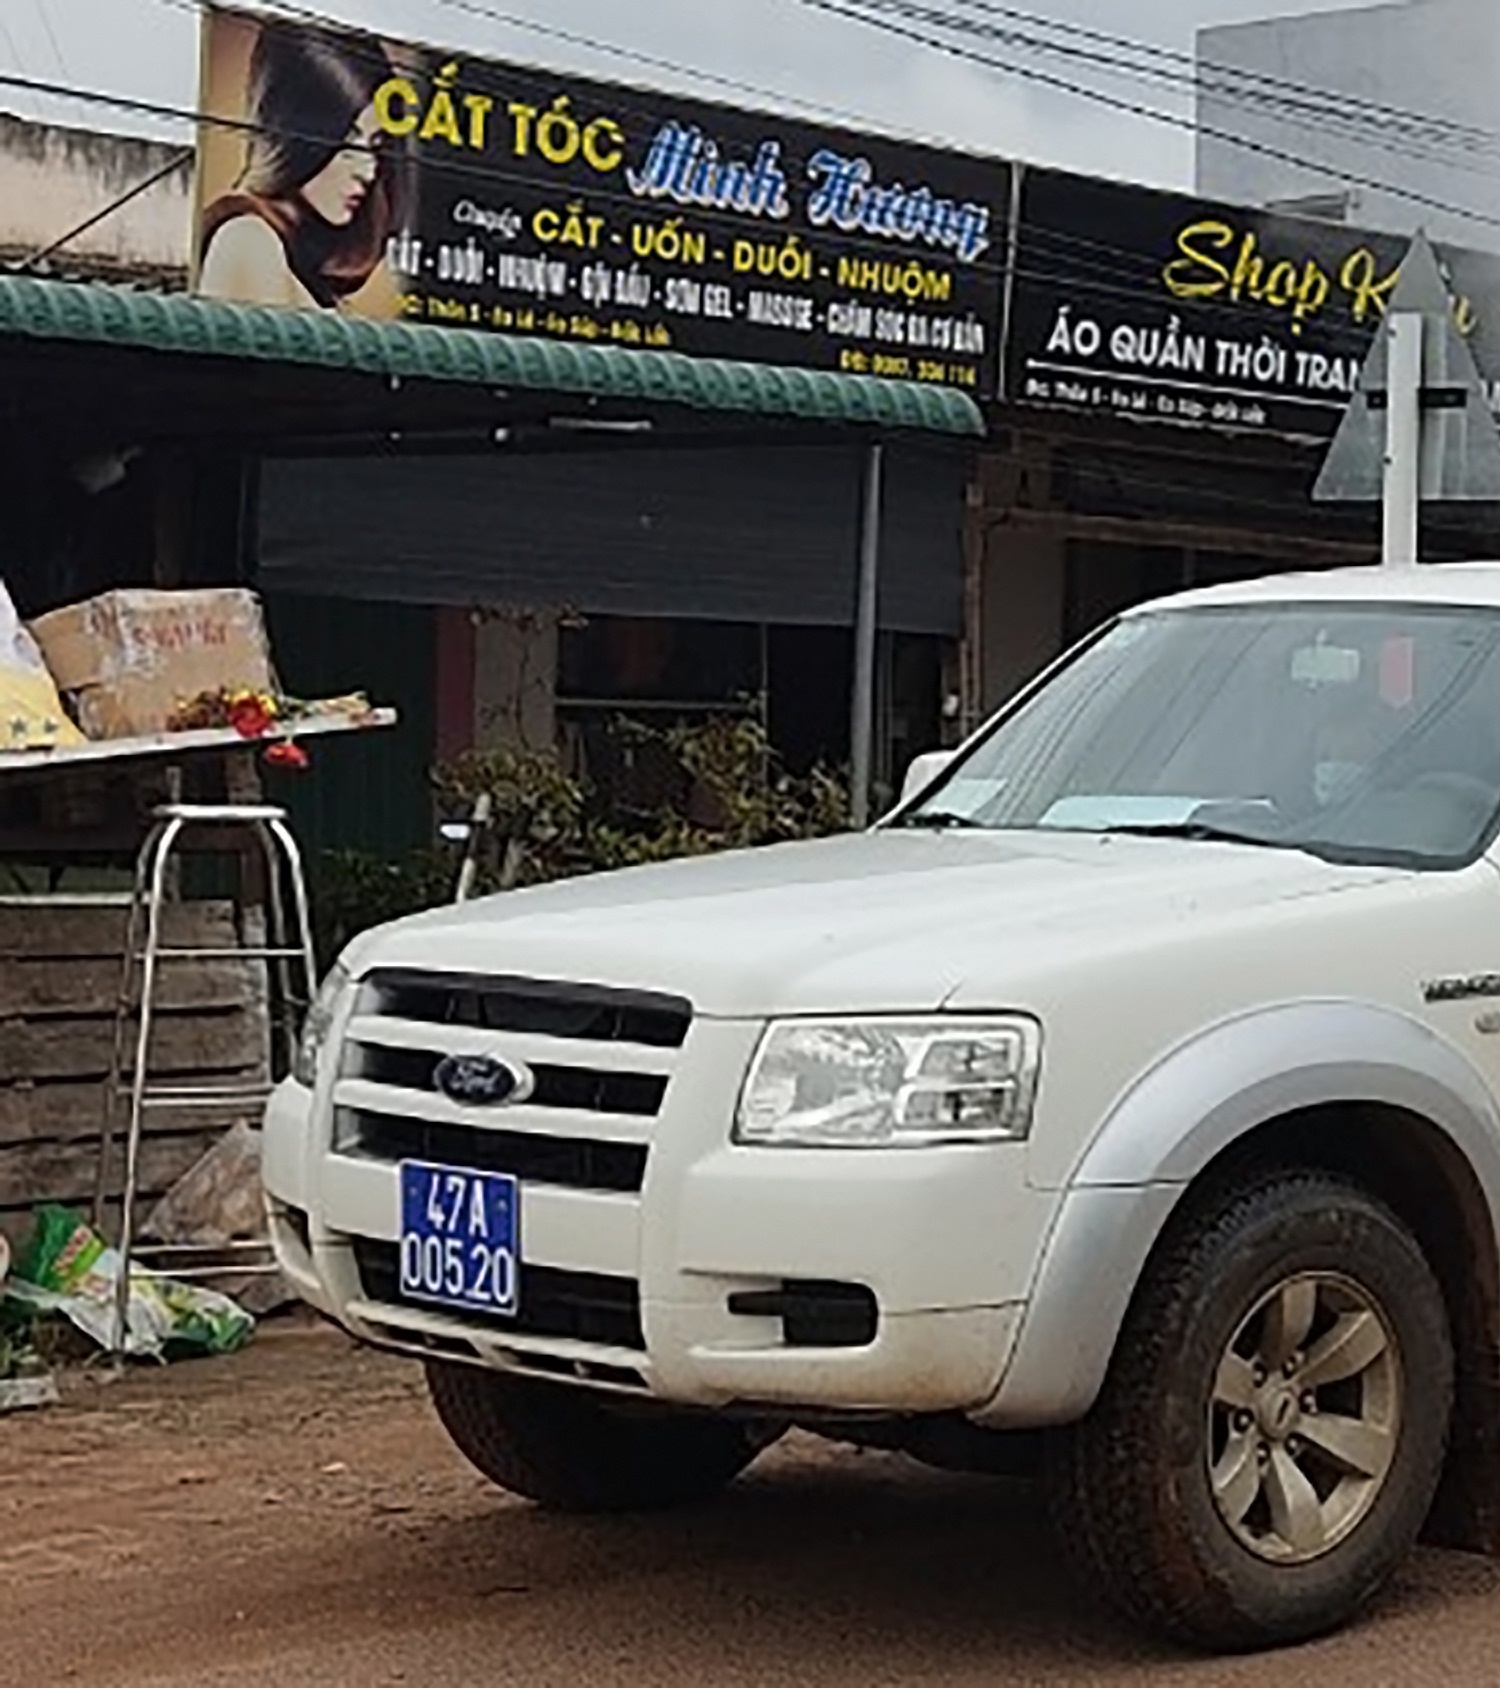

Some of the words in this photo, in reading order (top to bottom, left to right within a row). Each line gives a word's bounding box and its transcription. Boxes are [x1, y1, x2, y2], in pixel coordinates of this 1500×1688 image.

[374, 62, 492, 149] CẮT
[508, 95, 625, 172] TÓC
[626, 119, 789, 218] Minh
[532, 202, 604, 248] CẮT
[632, 215, 706, 264] UỐN
[837, 257, 951, 305] NHUỘM
[1163, 221, 1329, 336] Shop
[1047, 304, 1100, 355] ÁO
[1110, 314, 1205, 373] QUẦN
[1216, 335, 1286, 384] THỜI
[426, 1172, 489, 1238] 47A
